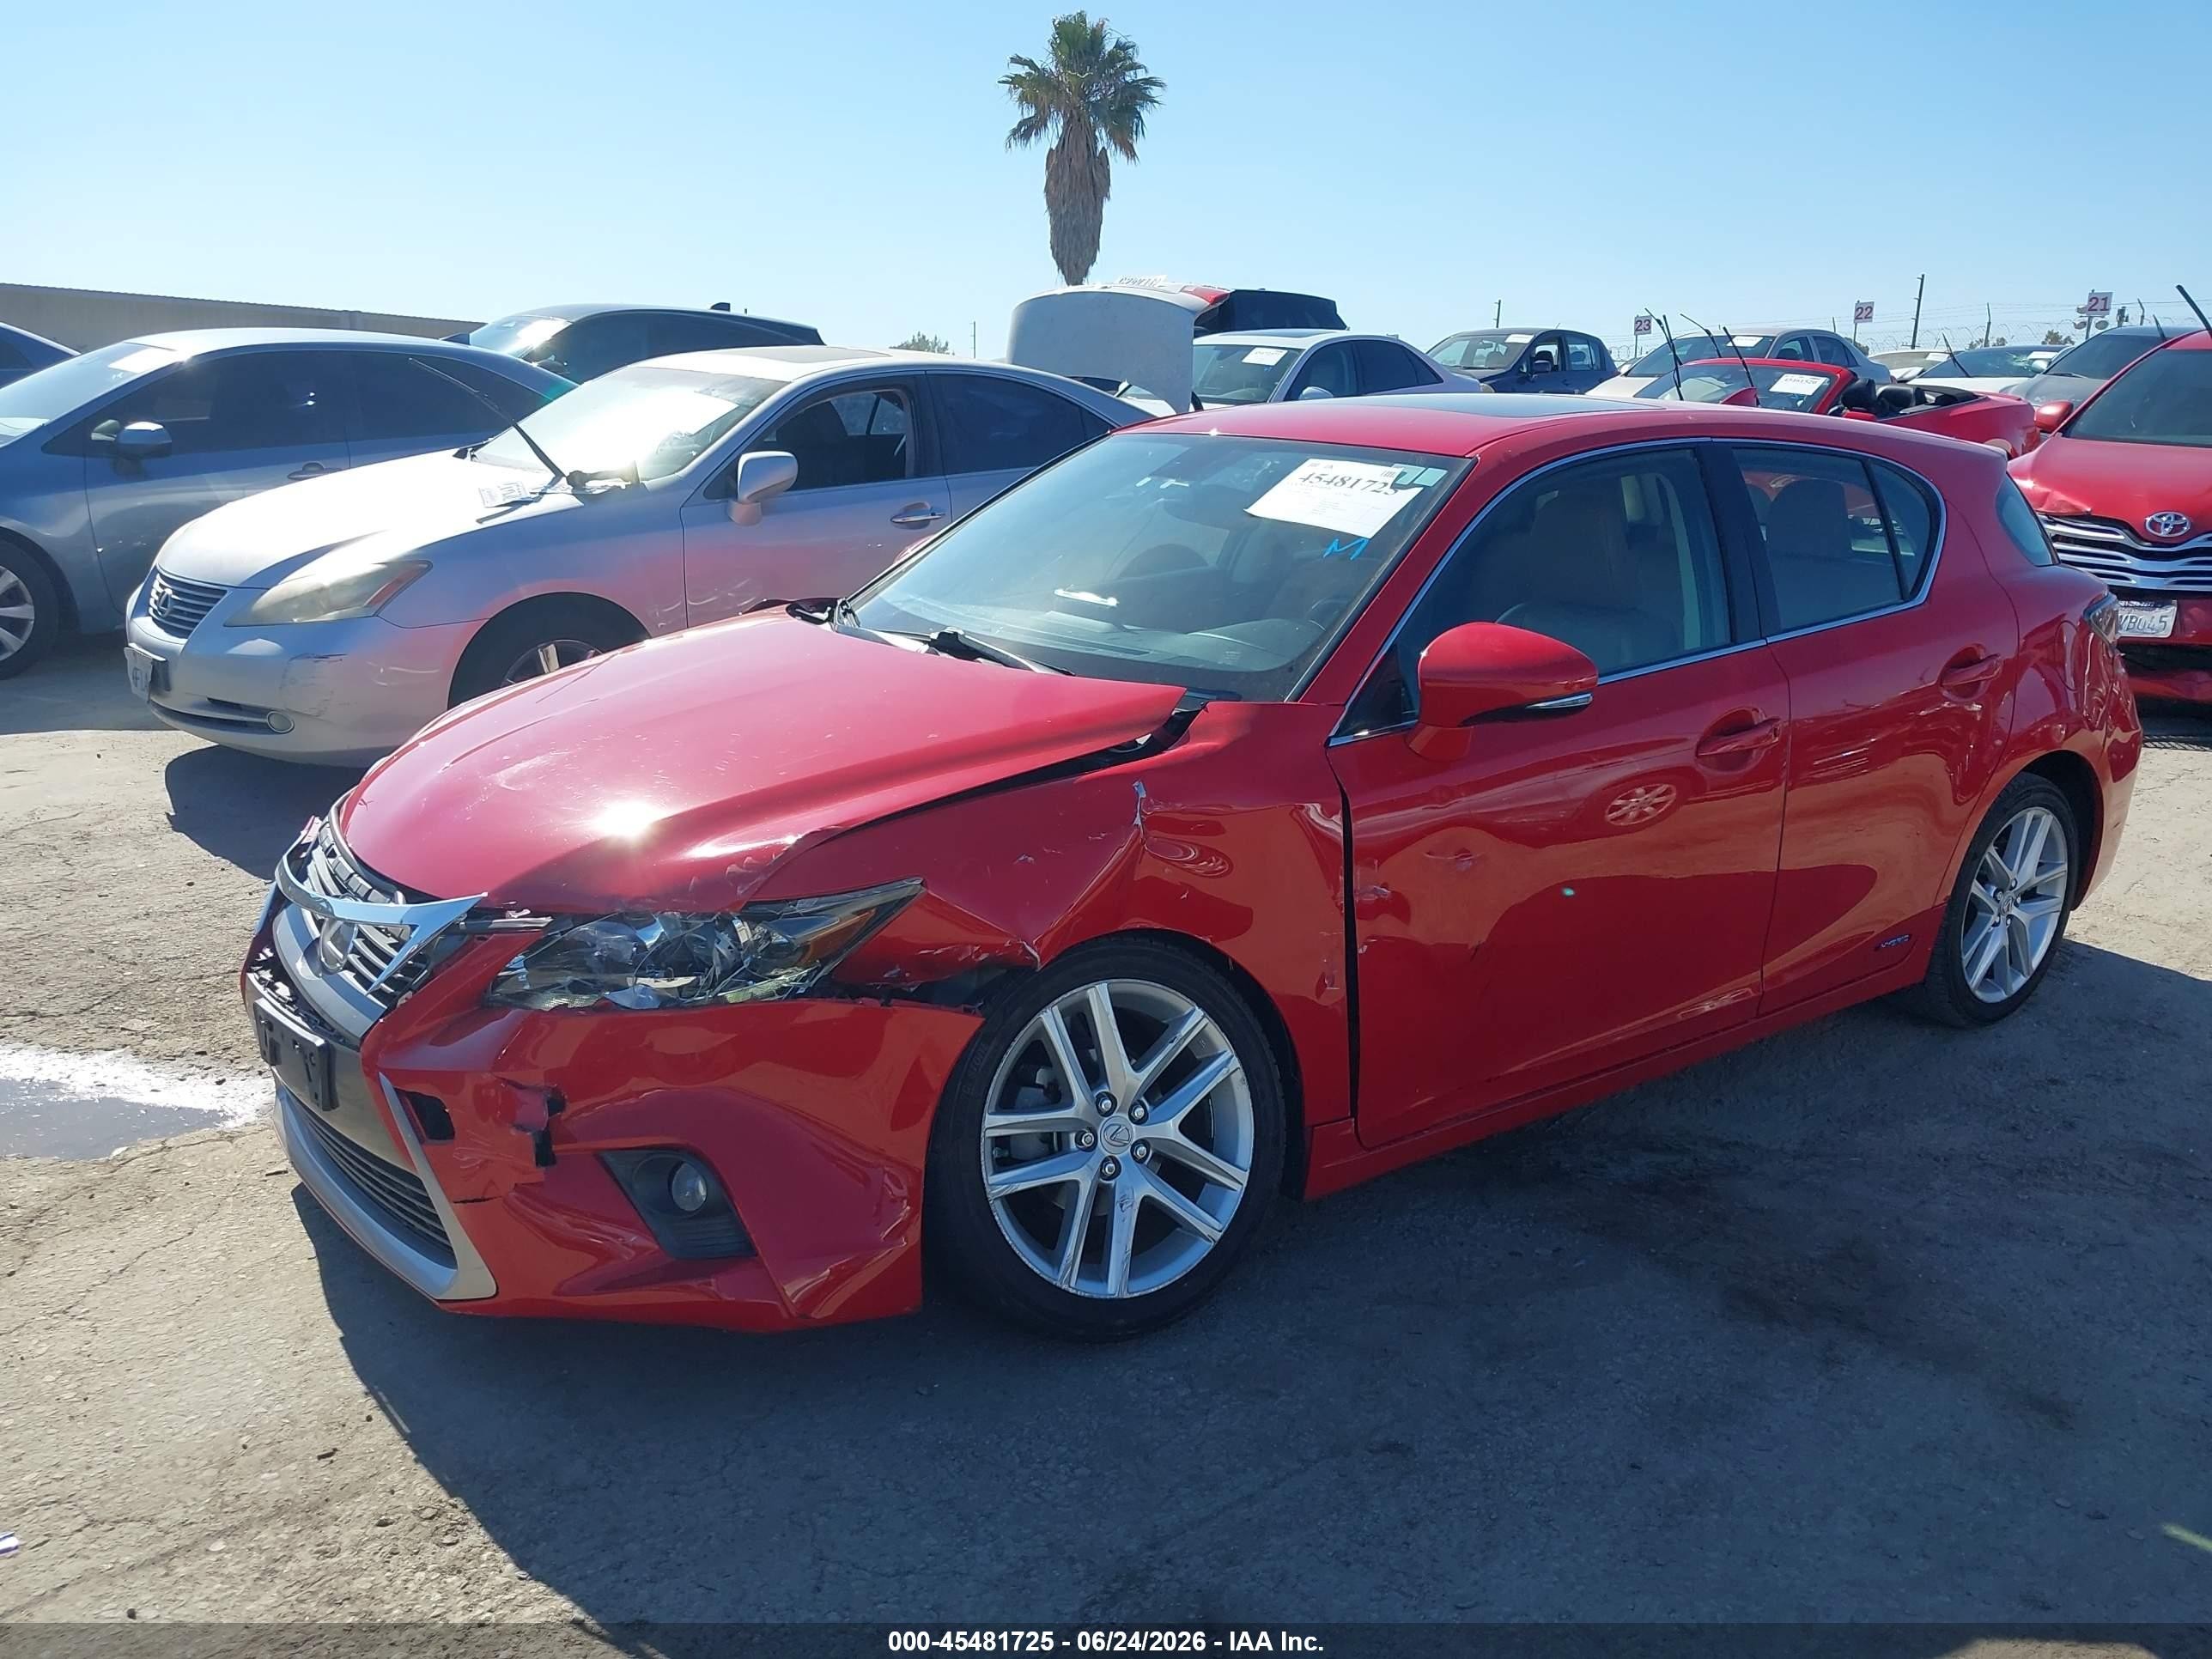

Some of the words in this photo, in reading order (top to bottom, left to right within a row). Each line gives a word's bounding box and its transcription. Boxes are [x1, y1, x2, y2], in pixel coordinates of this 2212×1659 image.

[2087, 296, 2110, 312] 21
[1855, 306, 1873, 319] 22
[1635, 319, 1650, 331] 23
[1322, 538, 1370, 561] M
